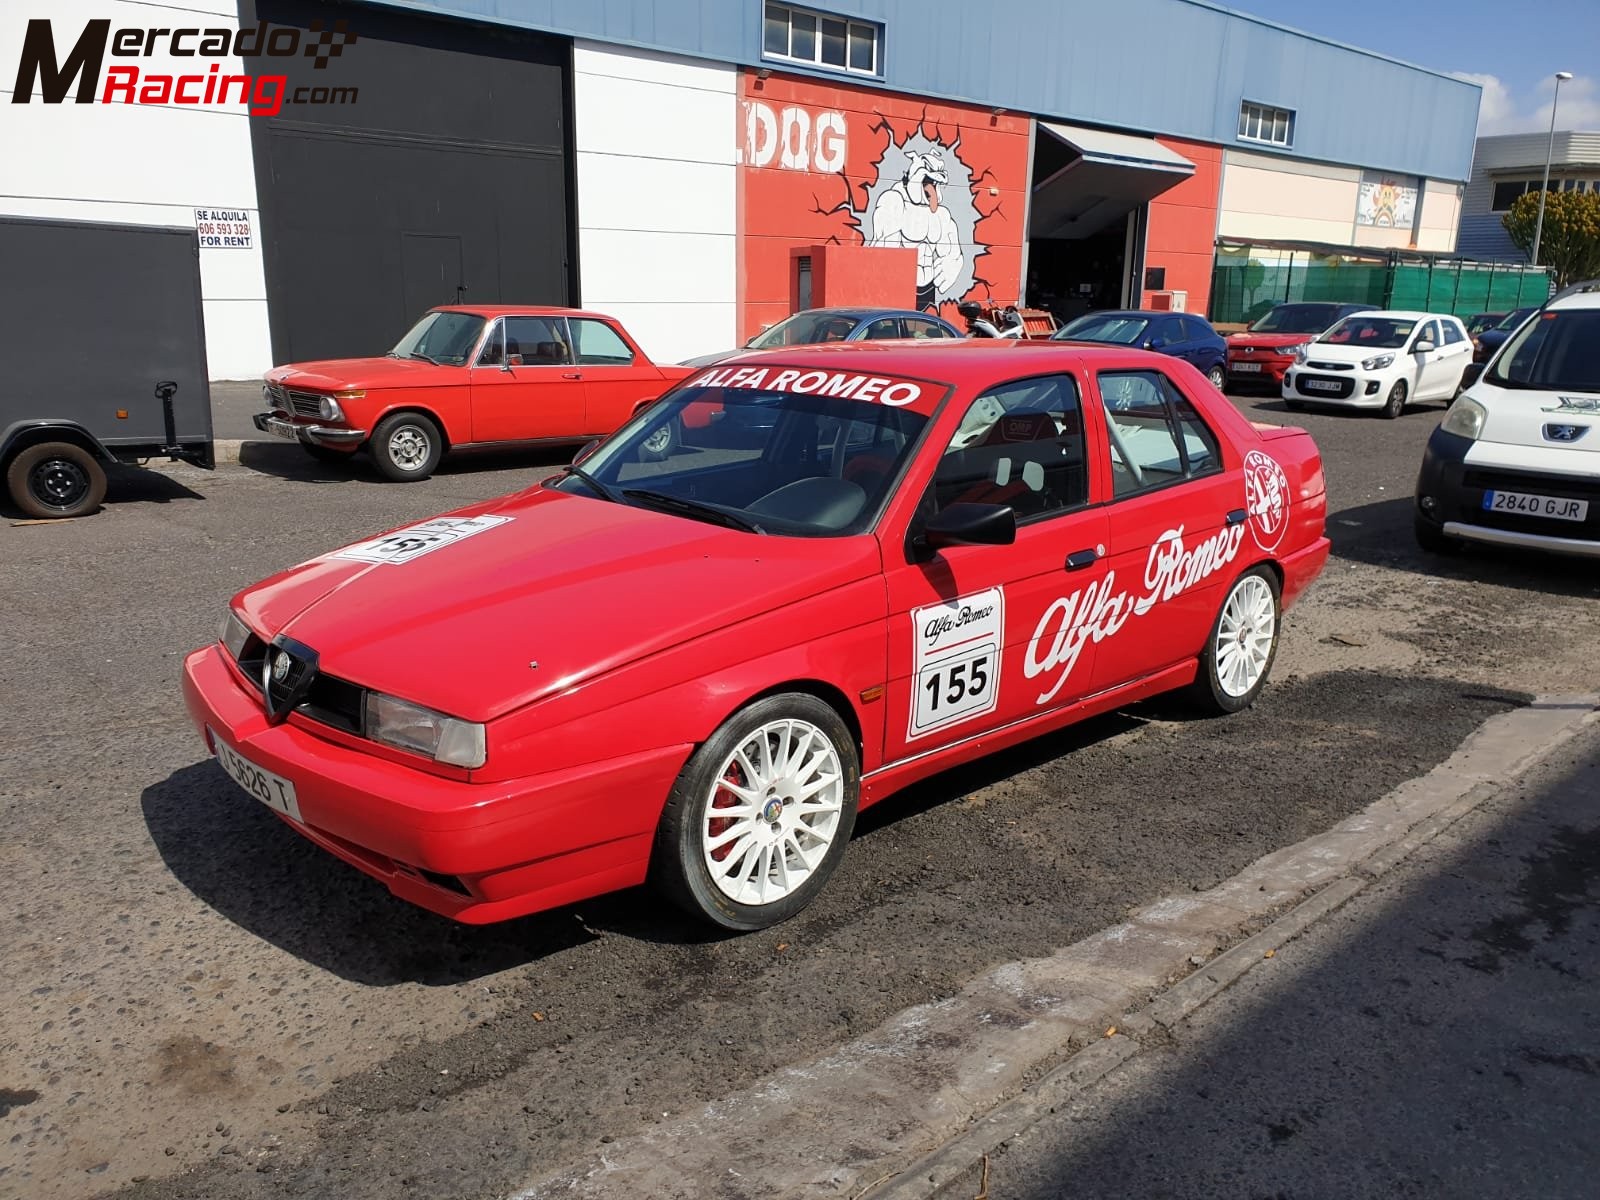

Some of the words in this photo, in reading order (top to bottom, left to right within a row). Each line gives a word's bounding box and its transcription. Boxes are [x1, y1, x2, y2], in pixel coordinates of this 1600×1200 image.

[736, 101, 847, 173] DOG
[197, 210, 209, 220] SE
[211, 211, 248, 221] ALQUILA
[199, 223, 215, 234] 606
[217, 223, 232, 235] 593
[234, 224, 249, 235] 328
[200, 236, 221, 246] FOR
[224, 237, 250, 246] RENT
[688, 367, 770, 388] ALFA
[765, 370, 922, 407] ROMEO
[1248, 454, 1287, 488] ROMEO
[1245, 468, 1256, 516] ALFA
[1495, 494, 1540, 512] 2840
[1545, 499, 1580, 518] GJR
[924, 614, 956, 646] Alfa
[955, 605, 994, 628] Romeo
[1023, 569, 1134, 705] Alfa
[1133, 523, 1245, 616] Romeo
[926, 656, 988, 711] 155
[228, 750, 271, 802] 5626
[273, 778, 289, 811] T
